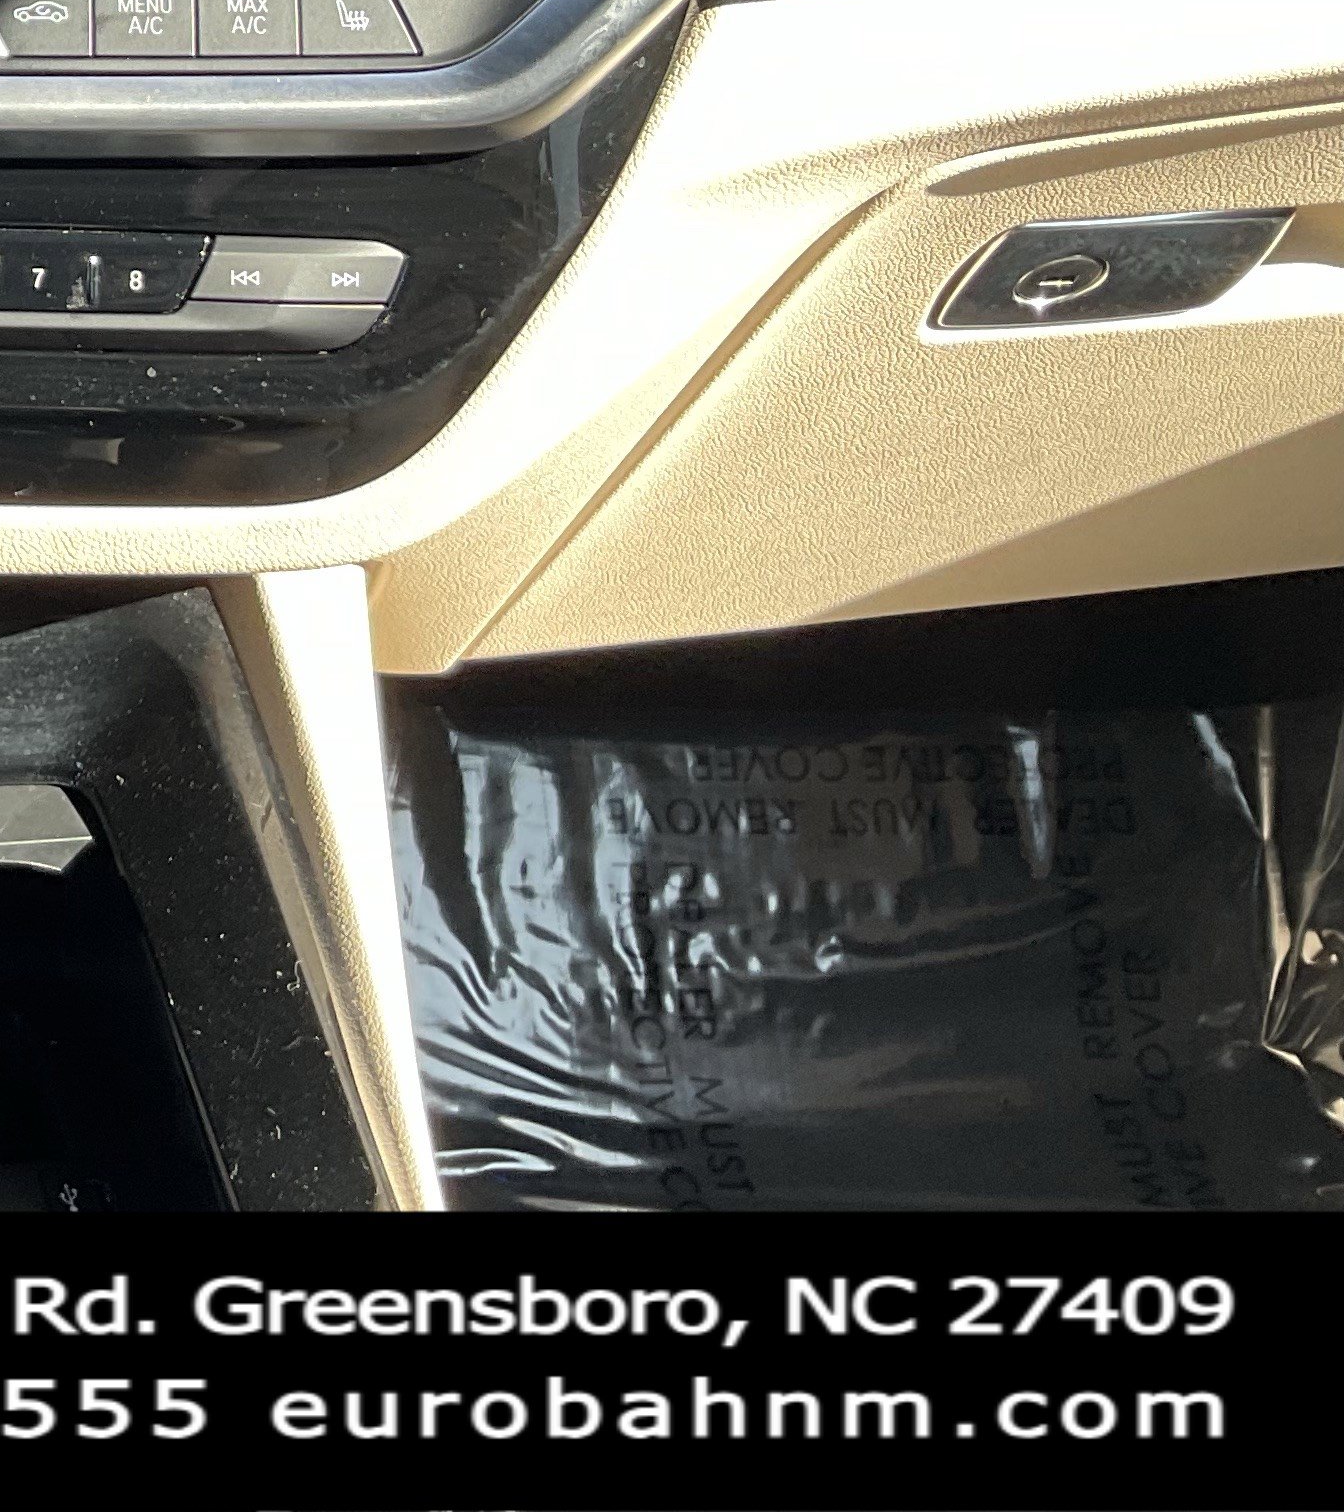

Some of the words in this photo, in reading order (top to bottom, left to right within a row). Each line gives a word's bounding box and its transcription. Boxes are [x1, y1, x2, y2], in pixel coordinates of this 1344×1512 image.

[127, 14, 164, 36] A/C
[230, 14, 267, 36] A/C
[32, 267, 46, 289] 7
[129, 269, 144, 291] 8
[688, 1074, 755, 1194] MUST
